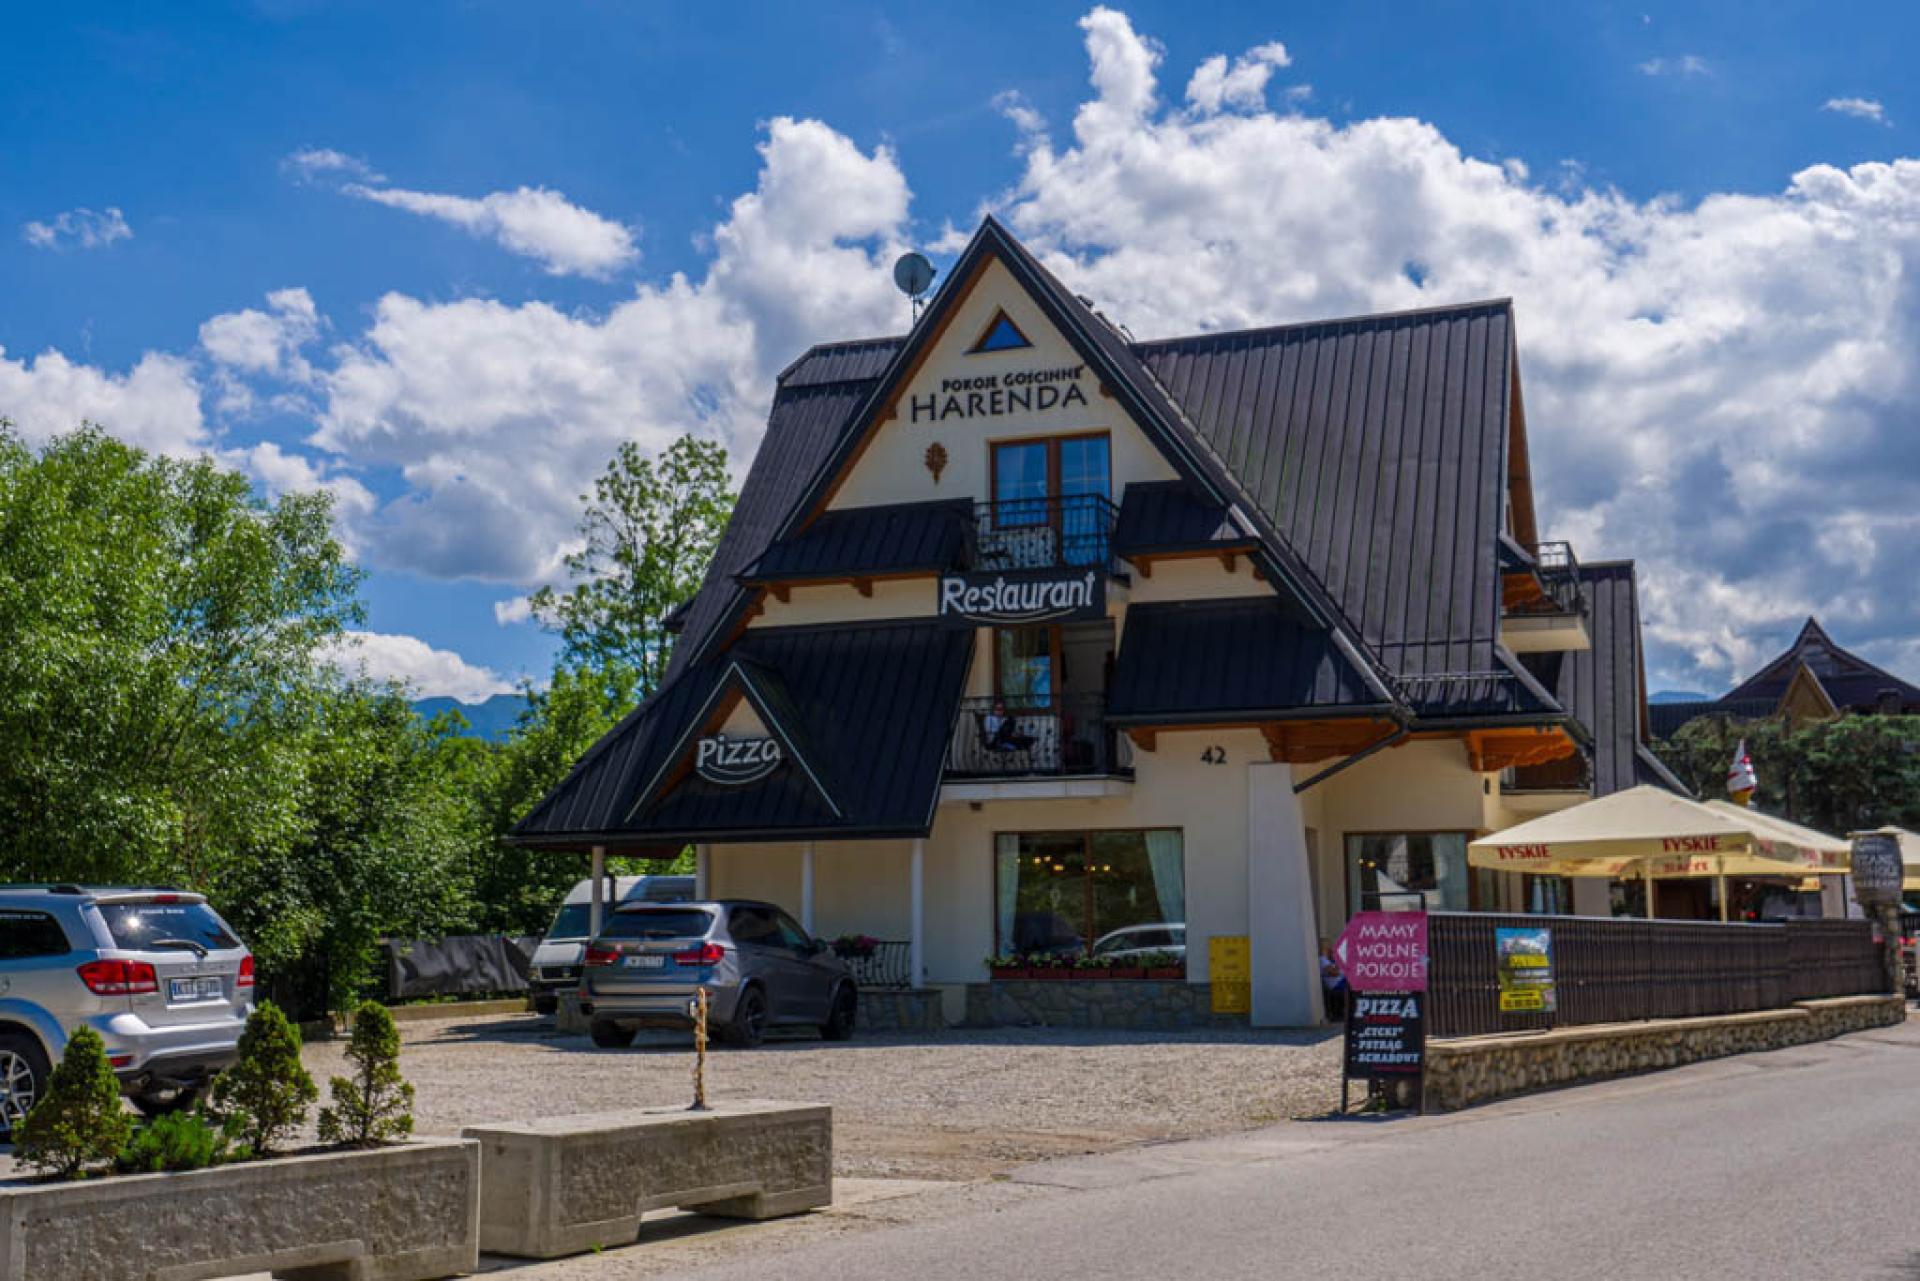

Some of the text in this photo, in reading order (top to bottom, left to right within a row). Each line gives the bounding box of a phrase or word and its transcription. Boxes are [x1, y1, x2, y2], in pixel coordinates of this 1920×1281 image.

[942, 375, 997, 393] POKOJE
[911, 382, 1088, 423] HARENDA
[941, 571, 1096, 615] Restaurant
[696, 735, 782, 768] Pizza
[1200, 745, 1228, 766] 42
[1498, 844, 1552, 860] TYSKIE
[1663, 835, 1722, 853] TYSKIE
[1359, 923, 1419, 939] MAMY
[1356, 942, 1420, 959] WOLNE
[1355, 961, 1420, 978] POKOJE
[1354, 997, 1419, 1019] PIZZA
